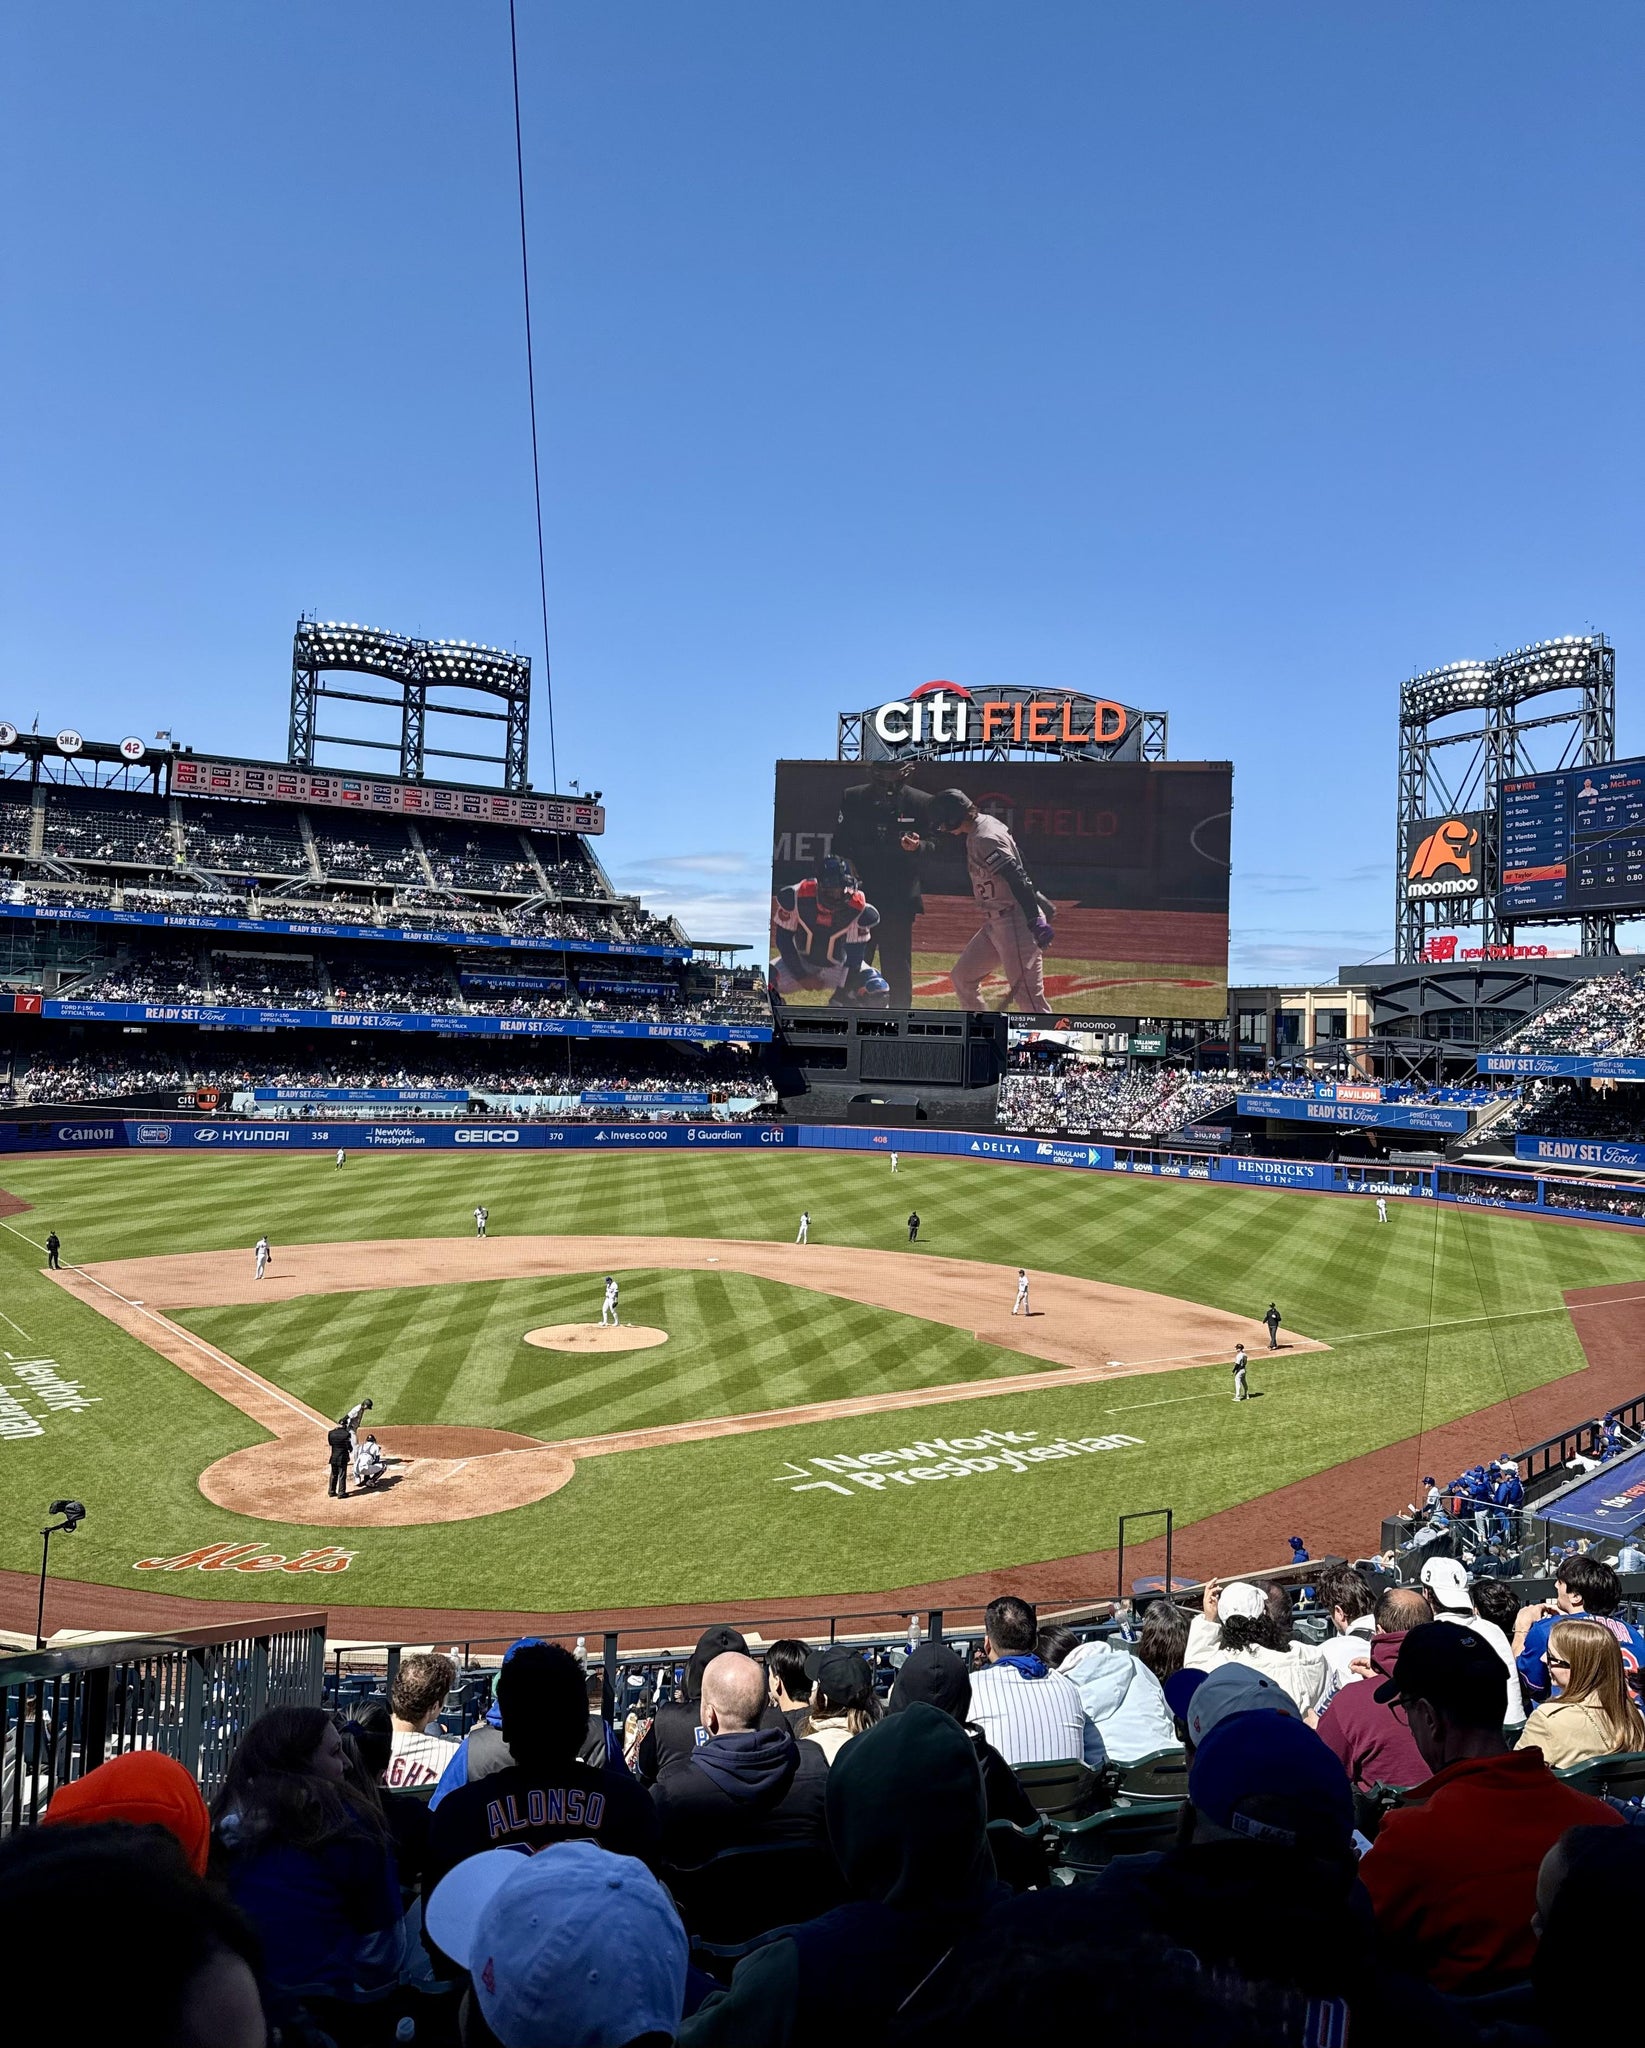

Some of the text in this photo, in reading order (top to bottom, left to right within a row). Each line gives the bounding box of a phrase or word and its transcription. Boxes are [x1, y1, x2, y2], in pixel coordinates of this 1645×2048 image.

[875, 690, 1127, 742] citi FIELD
[60, 736, 79, 747] SHEA
[124, 742, 140, 754] 42
[1504, 782, 1536, 792] NEW YORK
[1610, 779, 1641, 788] McLean
[1515, 794, 1540, 802] Bichette
[1024, 809, 1118, 837] FIELD
[1514, 820, 1535, 828] Robert
[1408, 878, 1479, 897] moomoo
[1580, 878, 1594, 886] 2.57
[36, 908, 91, 920] READY SET Ford
[290, 925, 310, 933] READY
[310, 926, 322, 934] SET
[1461, 944, 1548, 959] new balance
[24, 998, 34, 1010] 7
[146, 1008, 226, 1022] READY SET Ford
[331, 1014, 404, 1026] READY SET Ford
[500, 1020, 565, 1032] READY SET Ford
[1074, 1022, 1116, 1030] moomoo
[649, 1026, 708, 1038] READY SET Ford
[1488, 1059, 1560, 1072] READY SET Ford
[178, 1094, 195, 1104] citi
[206, 1094, 216, 1102] 10
[278, 1090, 299, 1098] READY
[1319, 1087, 1378, 1101] citi PAVILION
[1308, 1104, 1378, 1122] READY SET Ford
[1410, 1118, 1452, 1128] OFFICIAL TRUCK
[58, 1127, 114, 1141] Canon
[222, 1130, 290, 1141] HYUNDAI
[312, 1132, 328, 1140] 358
[375, 1128, 415, 1136] NewYork-
[454, 1130, 520, 1143] GEICO
[549, 1132, 564, 1140] 370
[610, 1131, 668, 1140] Invesco QQQ
[698, 1130, 742, 1140] Guardian
[760, 1128, 784, 1142] citi
[375, 1136, 426, 1146] Presbyterian
[872, 1136, 888, 1144] 408
[982, 1142, 1020, 1154] DELTA
[1538, 1141, 1639, 1165] READY SET Ford
[1053, 1150, 1087, 1158] HAUGLAND
[1054, 1156, 1074, 1164] GROUP
[1113, 1161, 1127, 1170] 380
[1133, 1163, 1153, 1172] GOYA
[1160, 1166, 1181, 1175] GOYA
[1188, 1168, 1208, 1177] GOYA
[1238, 1162, 1314, 1177] HENDRICK'S
[1265, 1175, 1287, 1184] GIN
[1534, 1176, 1560, 1184] CADILLAC
[1370, 1184, 1412, 1196] DUNKIN'
[1420, 1186, 1434, 1197] 370
[1456, 1194, 1506, 1208] CADILLAC
[8, 1359, 103, 1412] NewYork-
[808, 1429, 1038, 1474] NewYork-
[846, 1433, 1146, 1491] Presbyterian
[132, 1542, 360, 1574] Mets
[1425, 1570, 1431, 1582] 3
[487, 1788, 606, 1840] ALONSO
